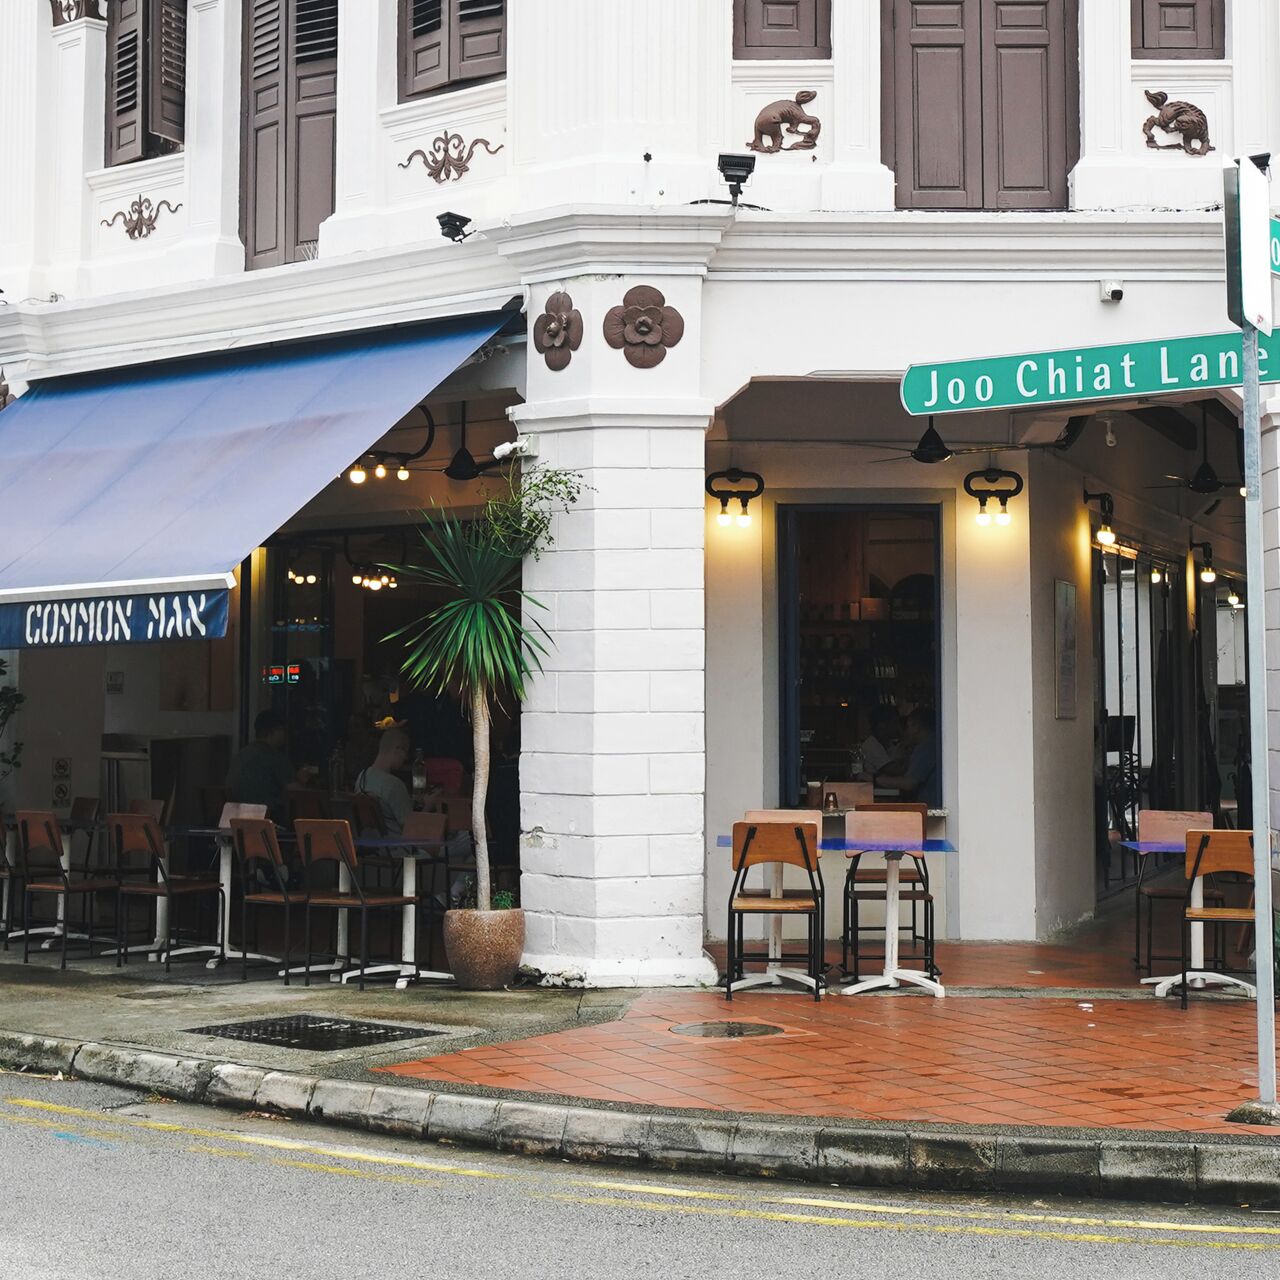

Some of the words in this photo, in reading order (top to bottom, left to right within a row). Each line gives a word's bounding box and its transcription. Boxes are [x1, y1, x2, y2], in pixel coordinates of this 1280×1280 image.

[924, 370, 994, 407] Joo
[1016, 352, 1136, 398] Chiat
[1160, 346, 1269, 385] Lane
[26, 599, 132, 644] COMMON
[147, 593, 206, 639] MAN
